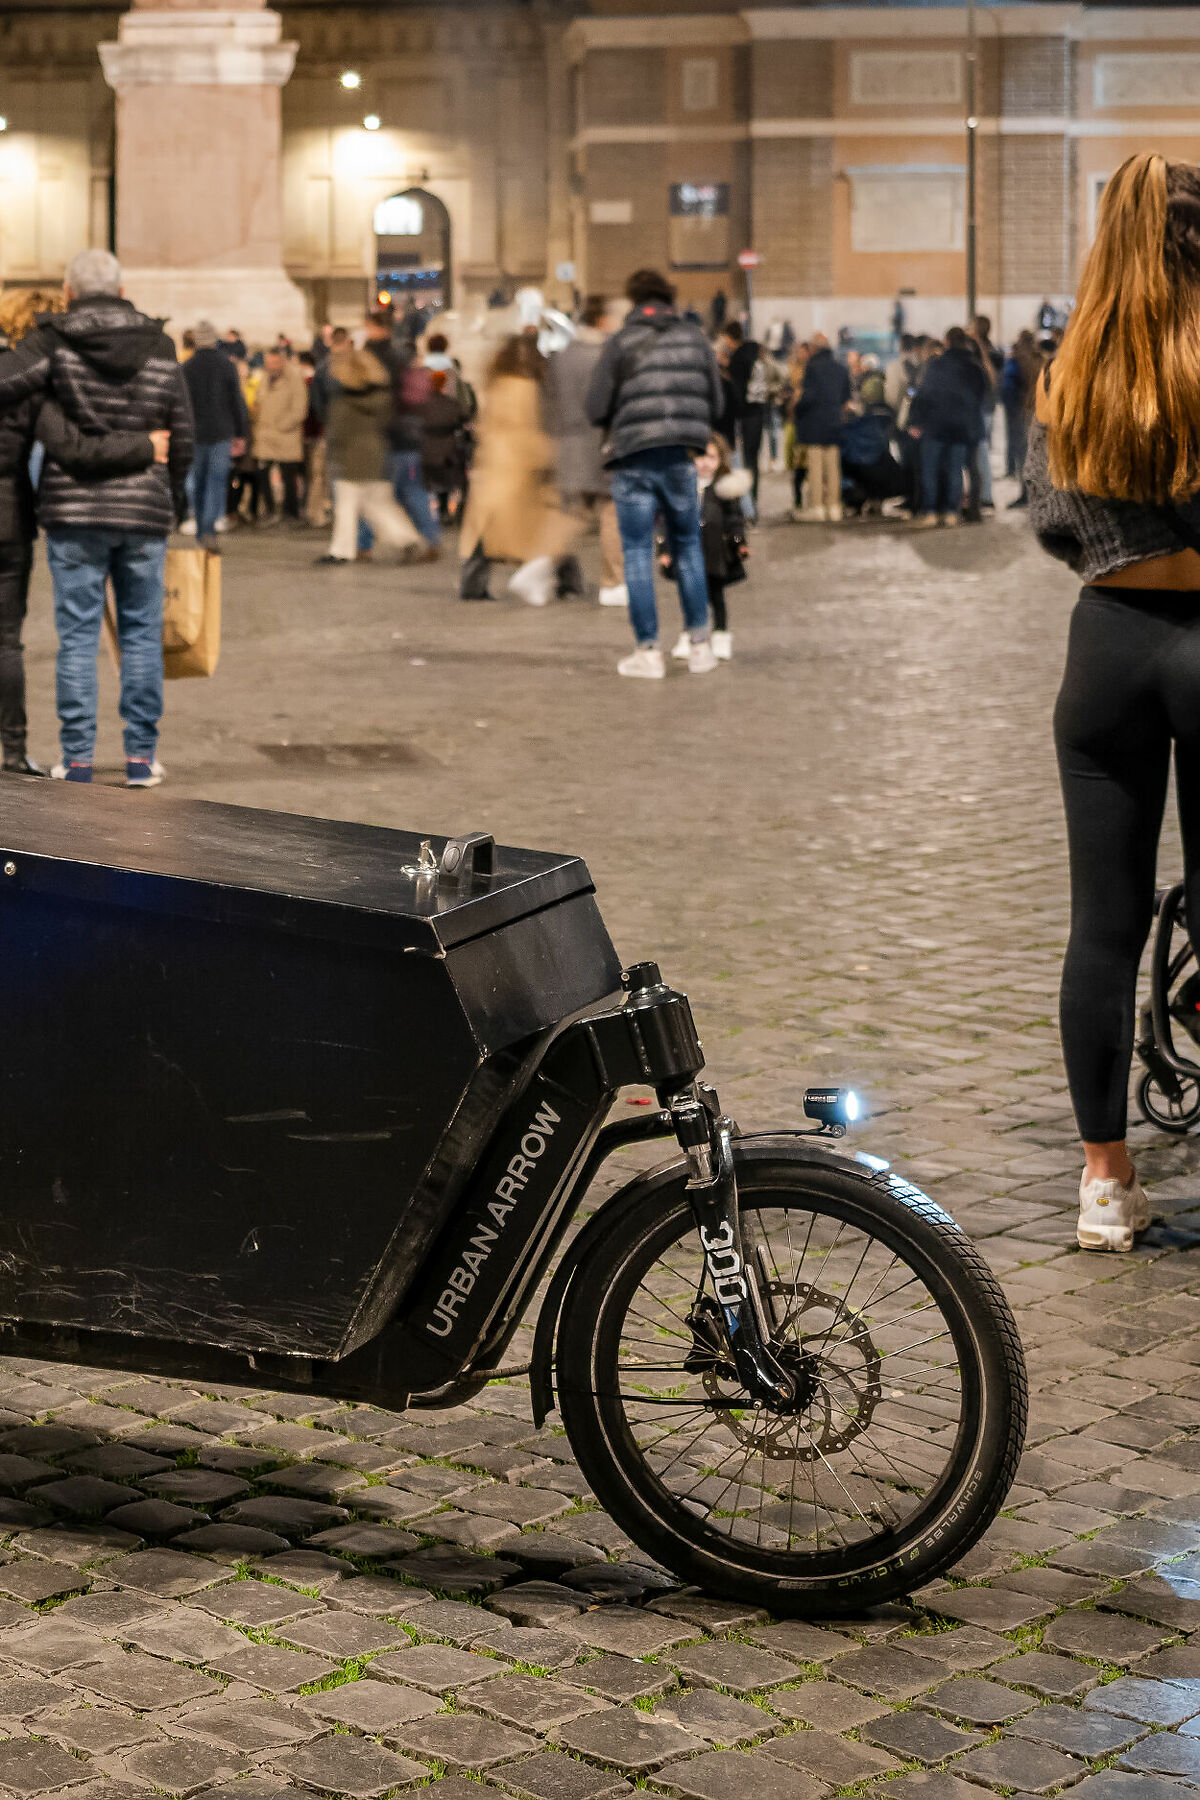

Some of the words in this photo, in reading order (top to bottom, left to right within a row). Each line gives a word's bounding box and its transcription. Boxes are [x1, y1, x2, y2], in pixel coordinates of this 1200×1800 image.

[426, 1223, 499, 1337] URBAN
[487, 1100, 562, 1228] ARROW
[924, 1470, 983, 1549] SCHWALBE
[838, 1558, 904, 1587] PICK-UP
